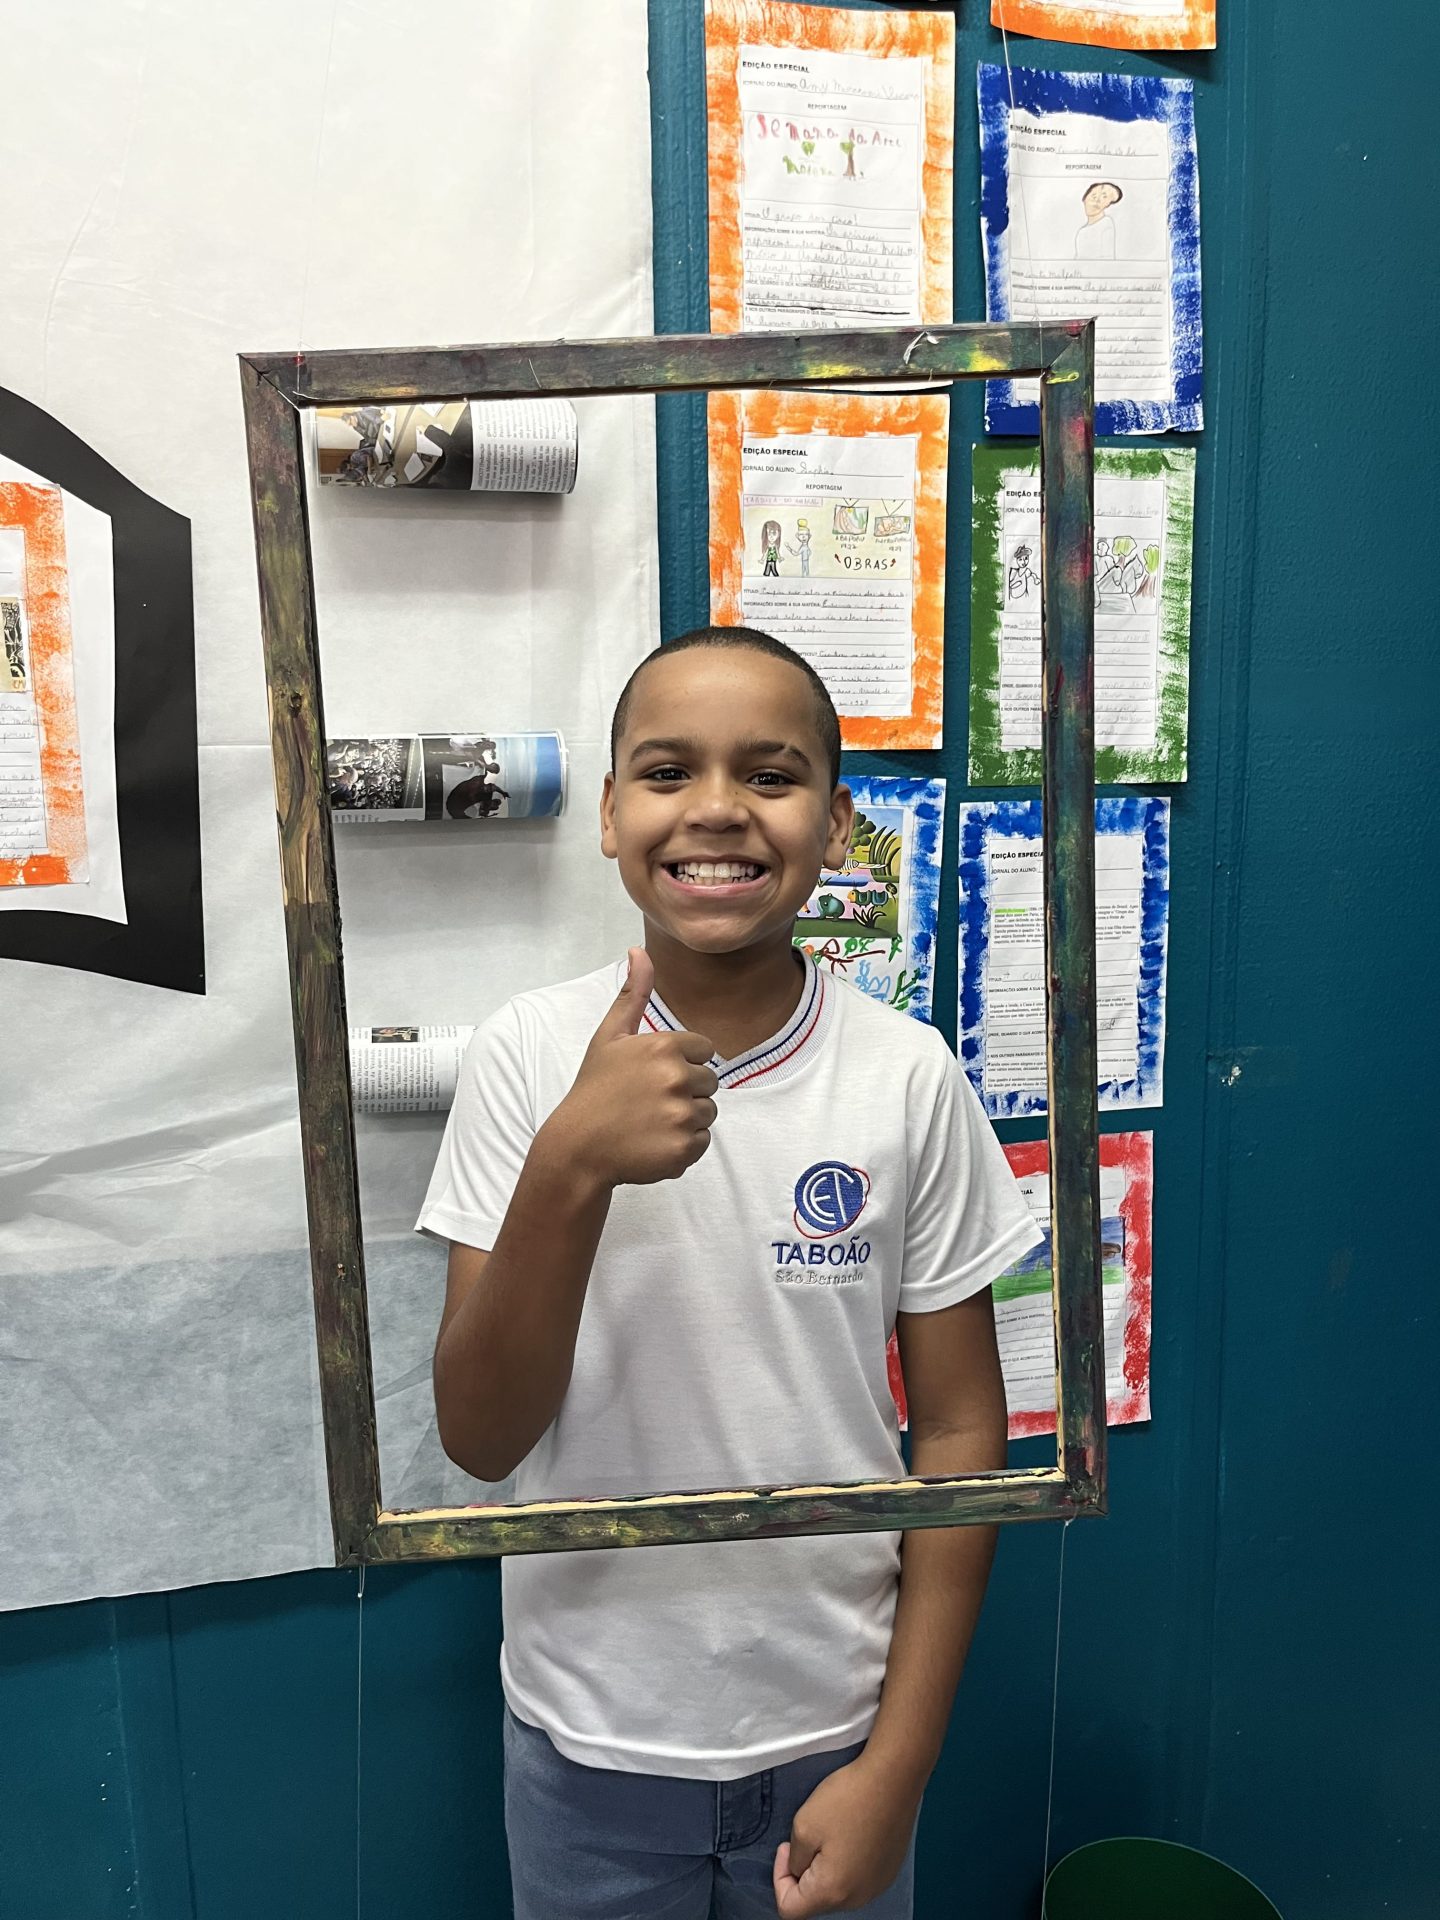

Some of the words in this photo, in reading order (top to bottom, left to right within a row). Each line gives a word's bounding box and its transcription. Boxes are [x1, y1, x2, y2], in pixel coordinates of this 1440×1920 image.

[742, 60, 772, 70] EDIÇÃO
[773, 63, 810, 73] ESPECIAL
[807, 103, 847, 111] REPORTAGEM
[1033, 128, 1067, 136] ESPECIAL
[742, 447, 771, 456] EDIÇÃO
[773, 448, 808, 457] ESPECIAL
[1006, 490, 1032, 499] EDIÇÃO
[843, 555, 888, 571] OBRAS
[991, 851, 1016, 860] EDIÇÃO
[771, 1235, 872, 1266] TABOÃO
[774, 1269, 804, 1284] São
[804, 1269, 864, 1285] Bernardo
